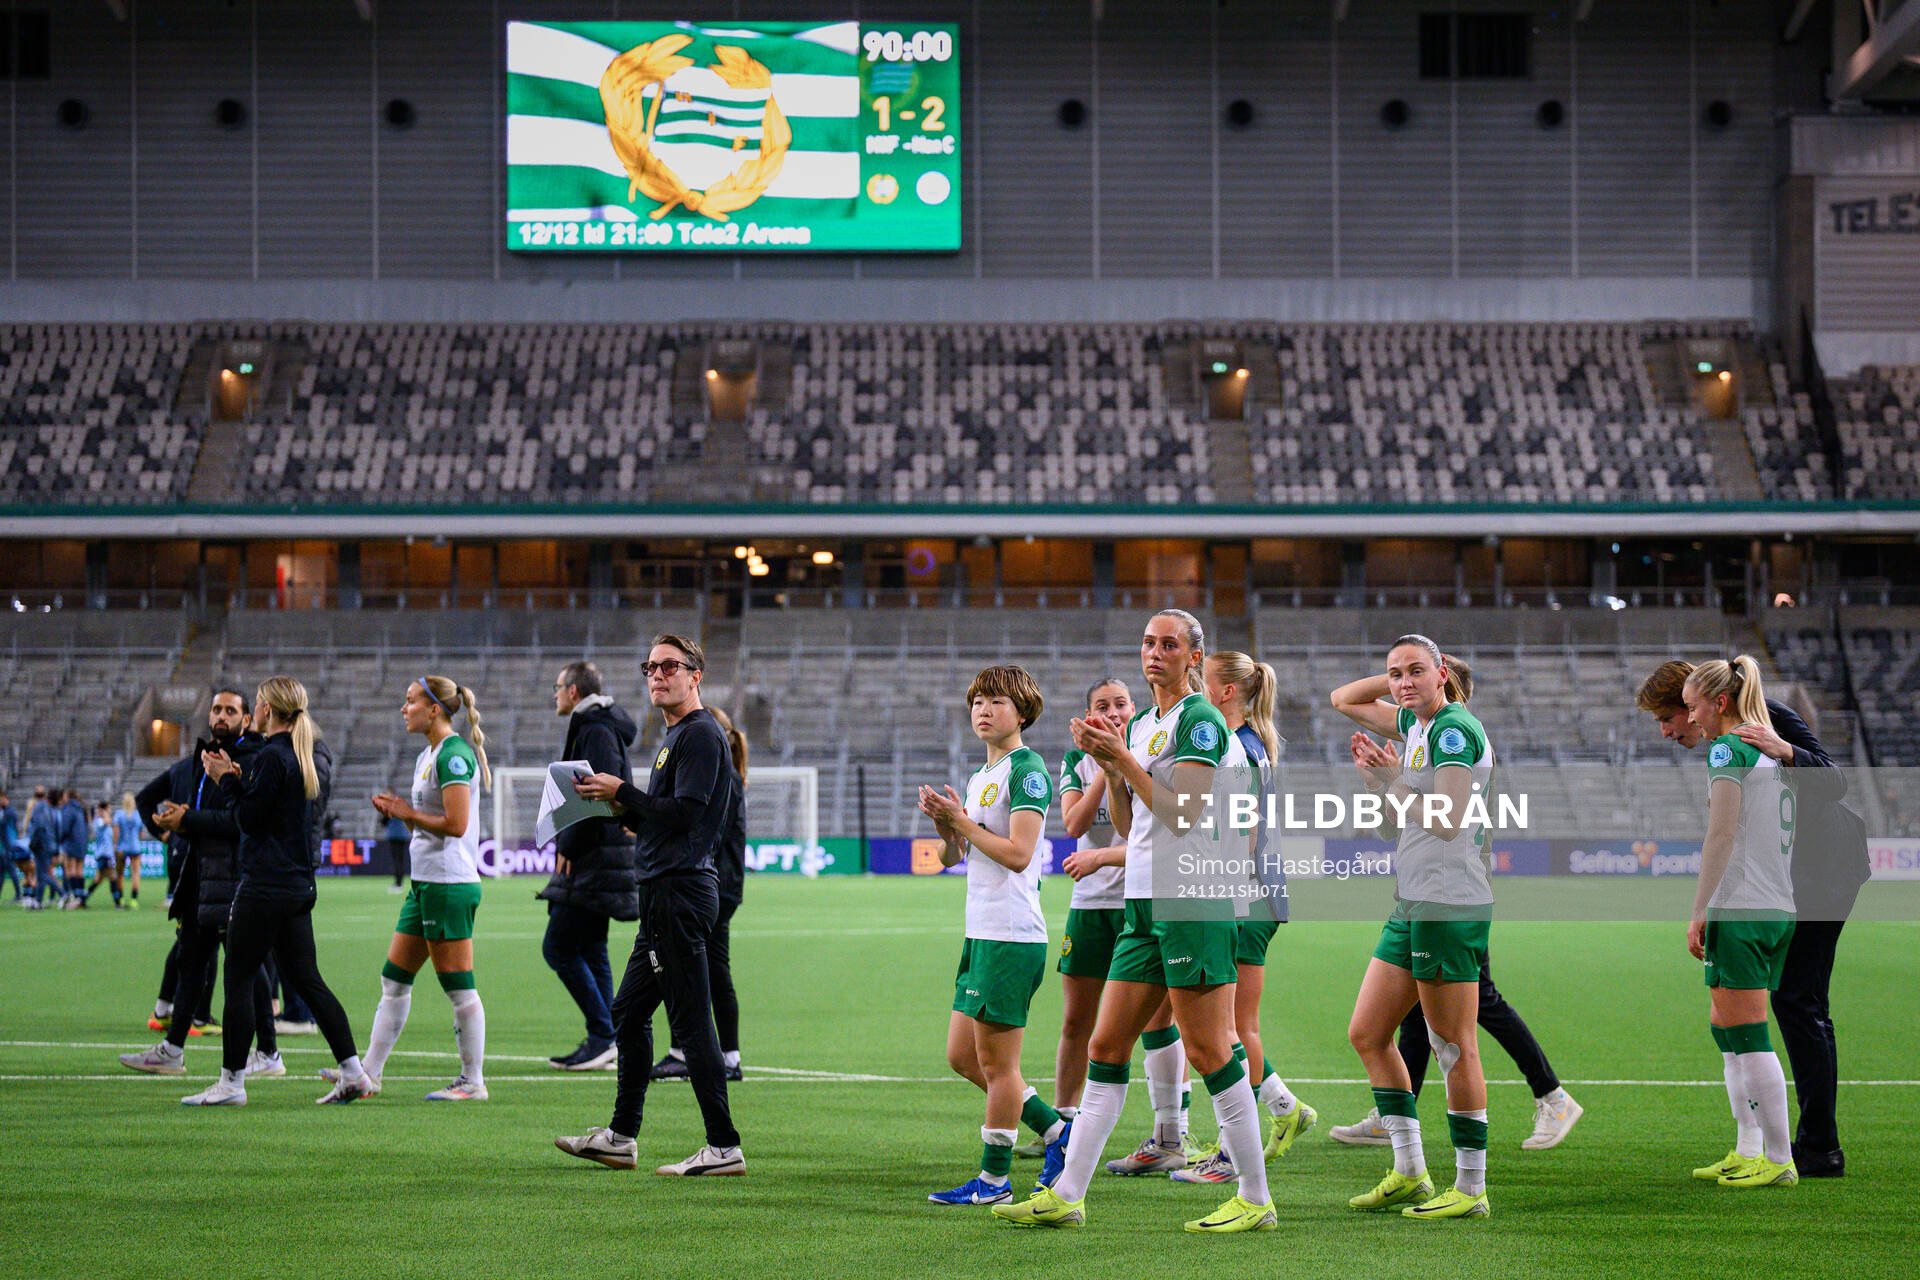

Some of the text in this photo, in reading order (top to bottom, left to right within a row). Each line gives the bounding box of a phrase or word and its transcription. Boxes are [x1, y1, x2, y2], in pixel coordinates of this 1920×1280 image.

[862, 31, 952, 62] 90:00
[872, 96, 890, 131] 1
[921, 96, 945, 131] 2
[519, 223, 579, 245] 12/12
[610, 223, 673, 245] 21:00
[1779, 789, 1796, 854] 9
[1168, 957, 1186, 965] CRAFT
